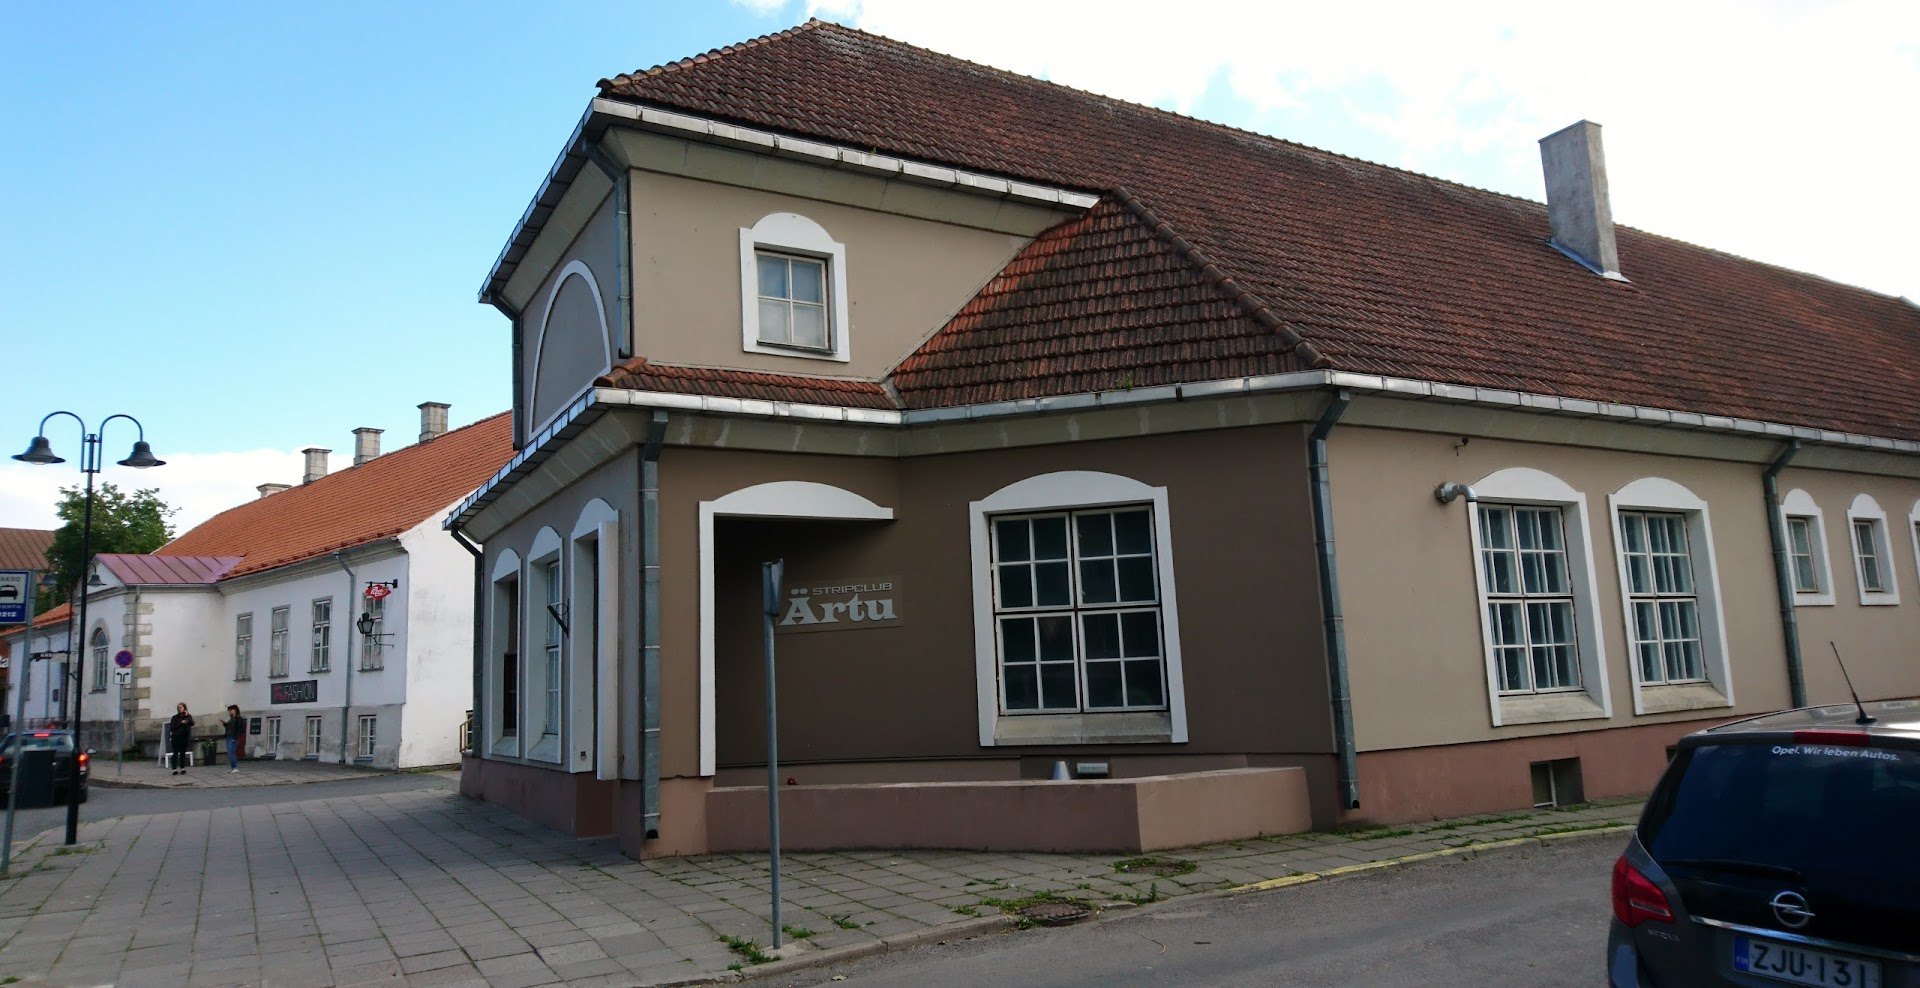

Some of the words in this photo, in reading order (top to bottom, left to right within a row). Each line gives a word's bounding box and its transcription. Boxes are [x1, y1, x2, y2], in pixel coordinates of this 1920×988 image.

[812, 582, 893, 596] STRIPCLUB
[779, 588, 898, 626] Ärtu
[284, 683, 315, 701] FASHION
[1772, 745, 1800, 756] Opel.
[1804, 746, 1823, 755] Wir
[1824, 747, 1858, 757] leben
[1859, 749, 1900, 761] Autos.
[1753, 944, 1866, 988] ZJU-131
